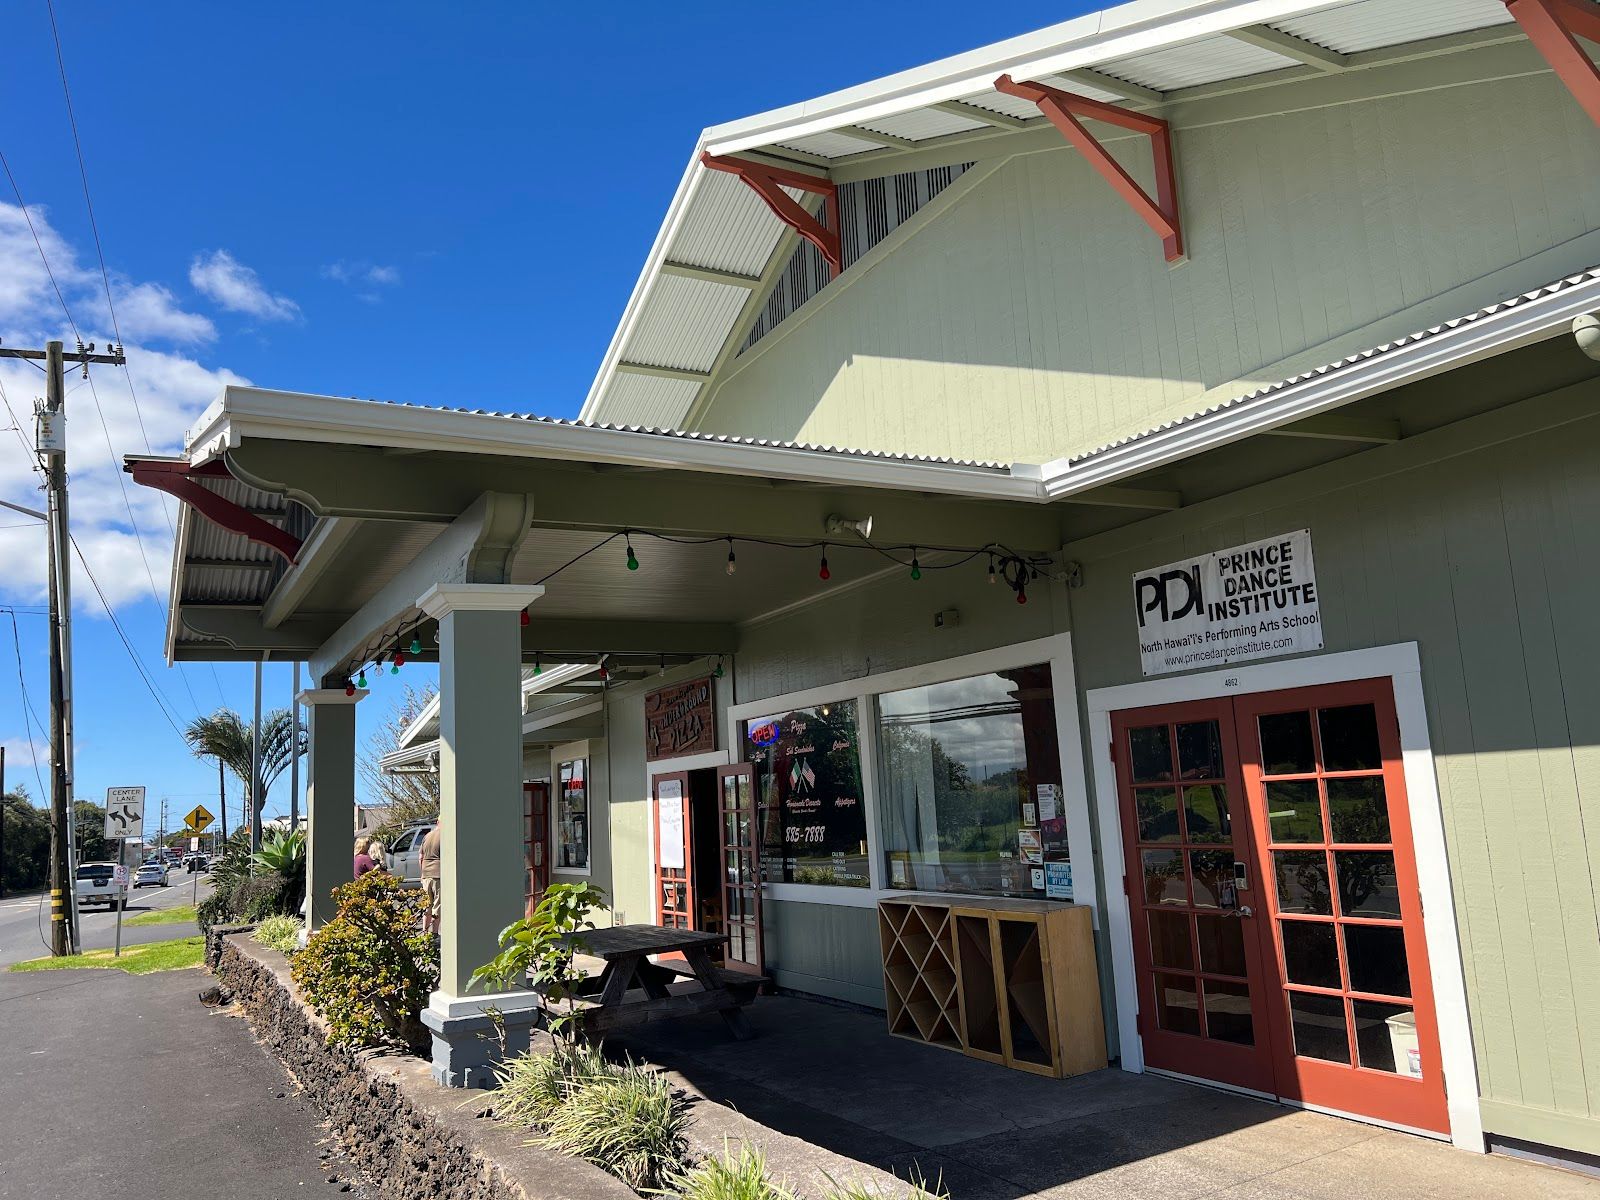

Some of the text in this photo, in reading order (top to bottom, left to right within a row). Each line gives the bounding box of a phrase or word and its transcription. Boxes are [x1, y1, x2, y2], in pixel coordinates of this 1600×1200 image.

[1219, 542, 1293, 576] PRINCE
[1136, 564, 1205, 627] PDI
[1224, 565, 1292, 597] DANCE
[1208, 583, 1316, 622] INSTITUTE
[1141, 641, 1163, 654] North
[1205, 625, 1257, 643] Performing
[1259, 619, 1280, 632] Arts
[1282, 611, 1319, 629] School
[1165, 637, 1293, 666] www.princedanceinstitute.com
[751, 723, 777, 743] OPEN
[786, 826, 825, 843] 885-7888
